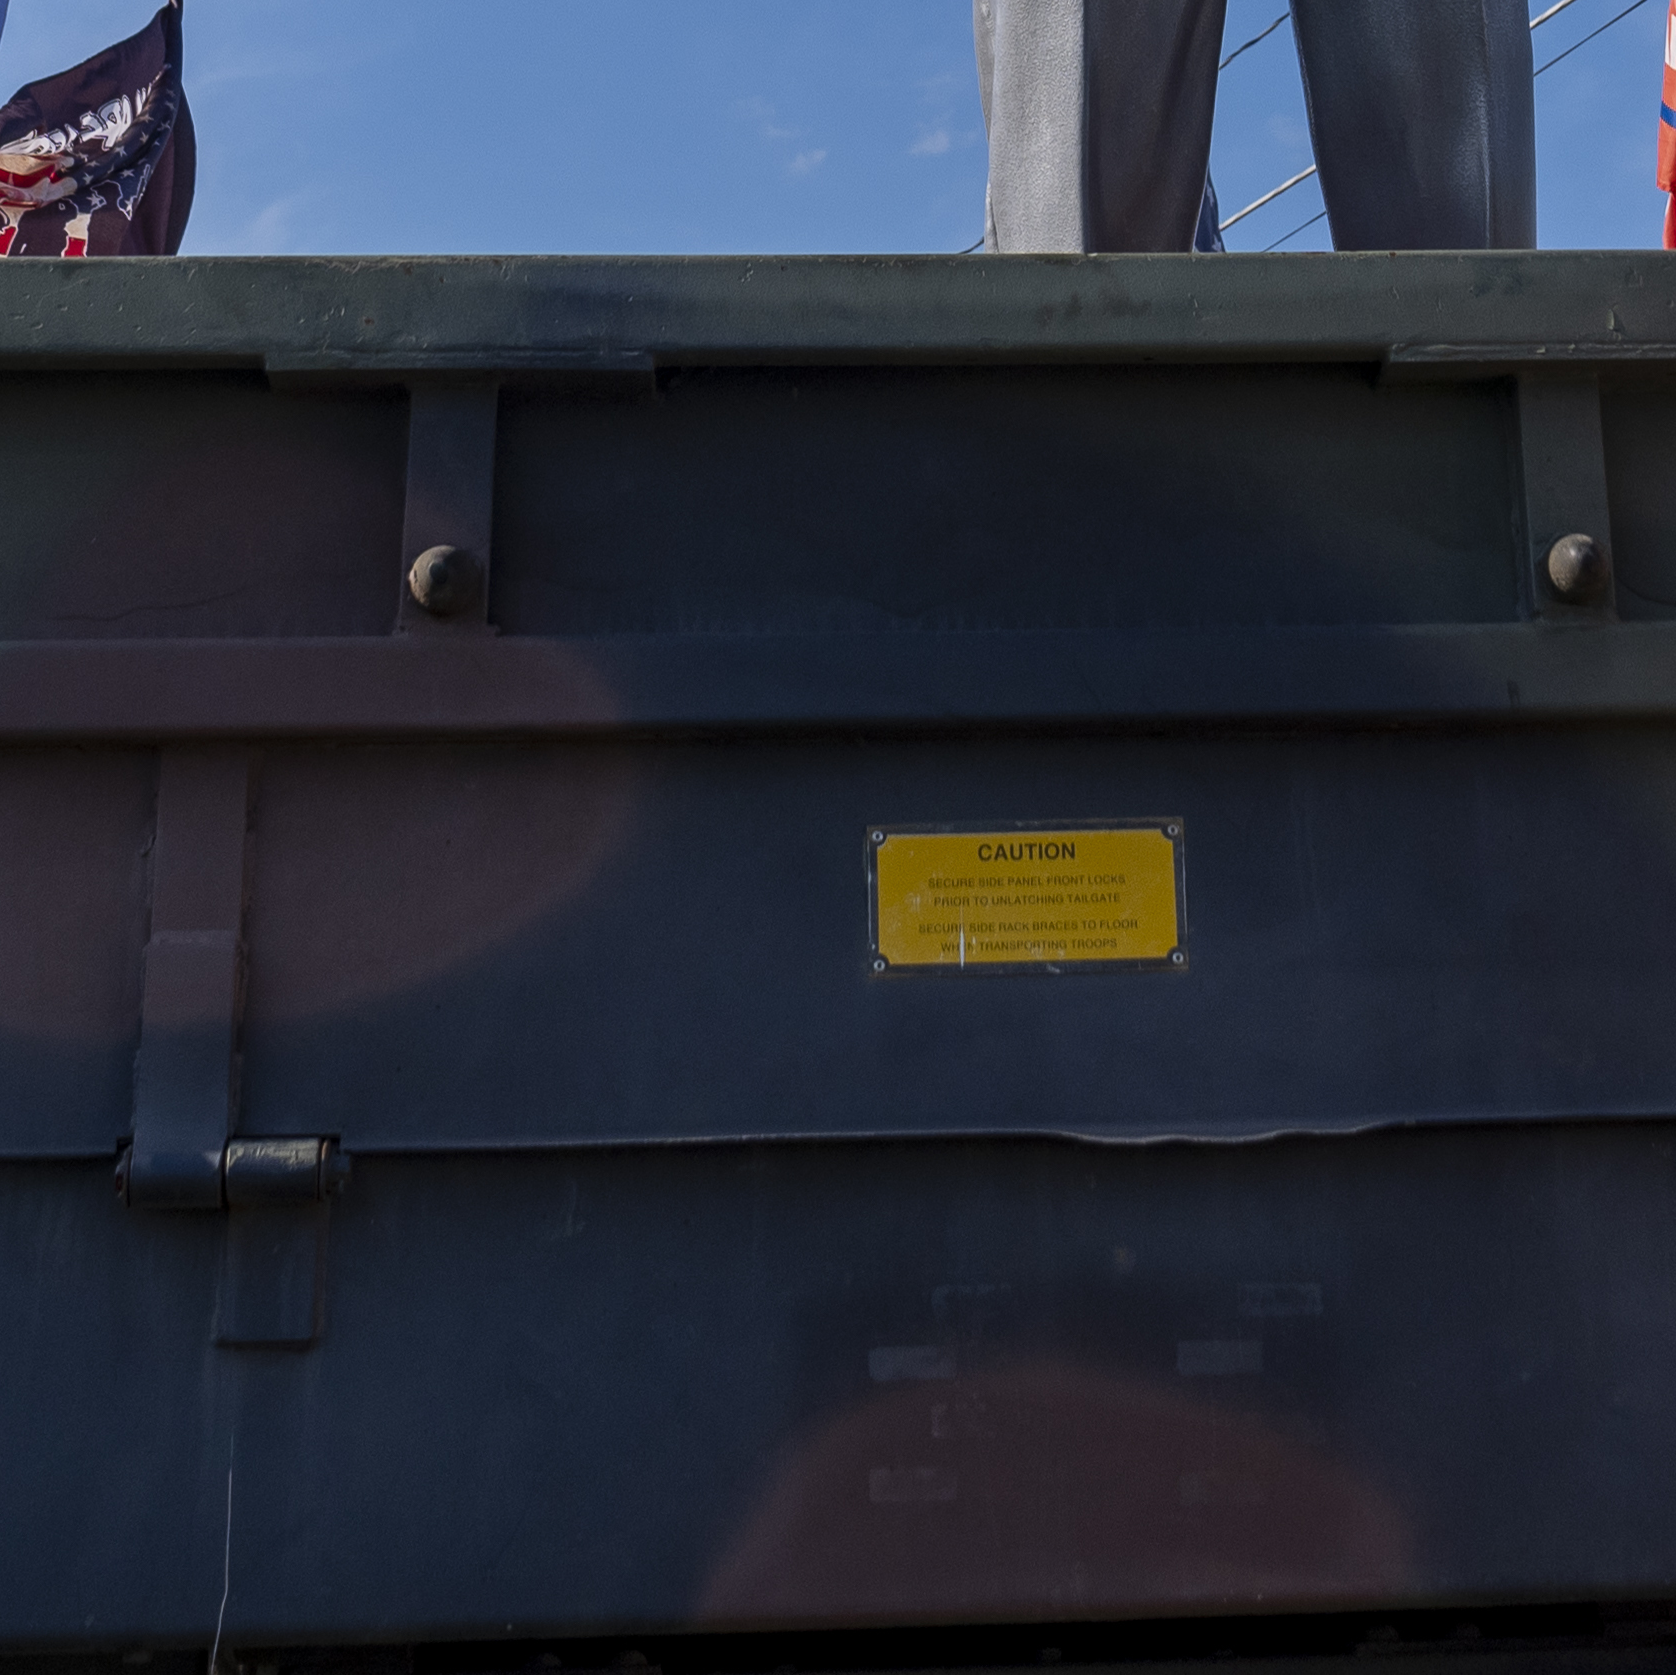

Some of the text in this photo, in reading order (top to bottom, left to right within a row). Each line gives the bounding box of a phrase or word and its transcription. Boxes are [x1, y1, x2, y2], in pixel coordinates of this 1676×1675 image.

[978, 842, 1076, 862] CAUTION
[928, 873, 1126, 889] SECURE SIDE PANEL FRONT LOCKS
[933, 892, 1120, 907] PRIOR TO UNLATCHING TAILGATE
[968, 922, 996, 933] SIDE
[998, 921, 1029, 932] RACK
[1032, 920, 1079, 932] BRACES
[1082, 919, 1097, 931] TO
[1099, 918, 1139, 930] FLOOR
[941, 937, 1118, 952] WHN TRANSPORTING TROOPS
